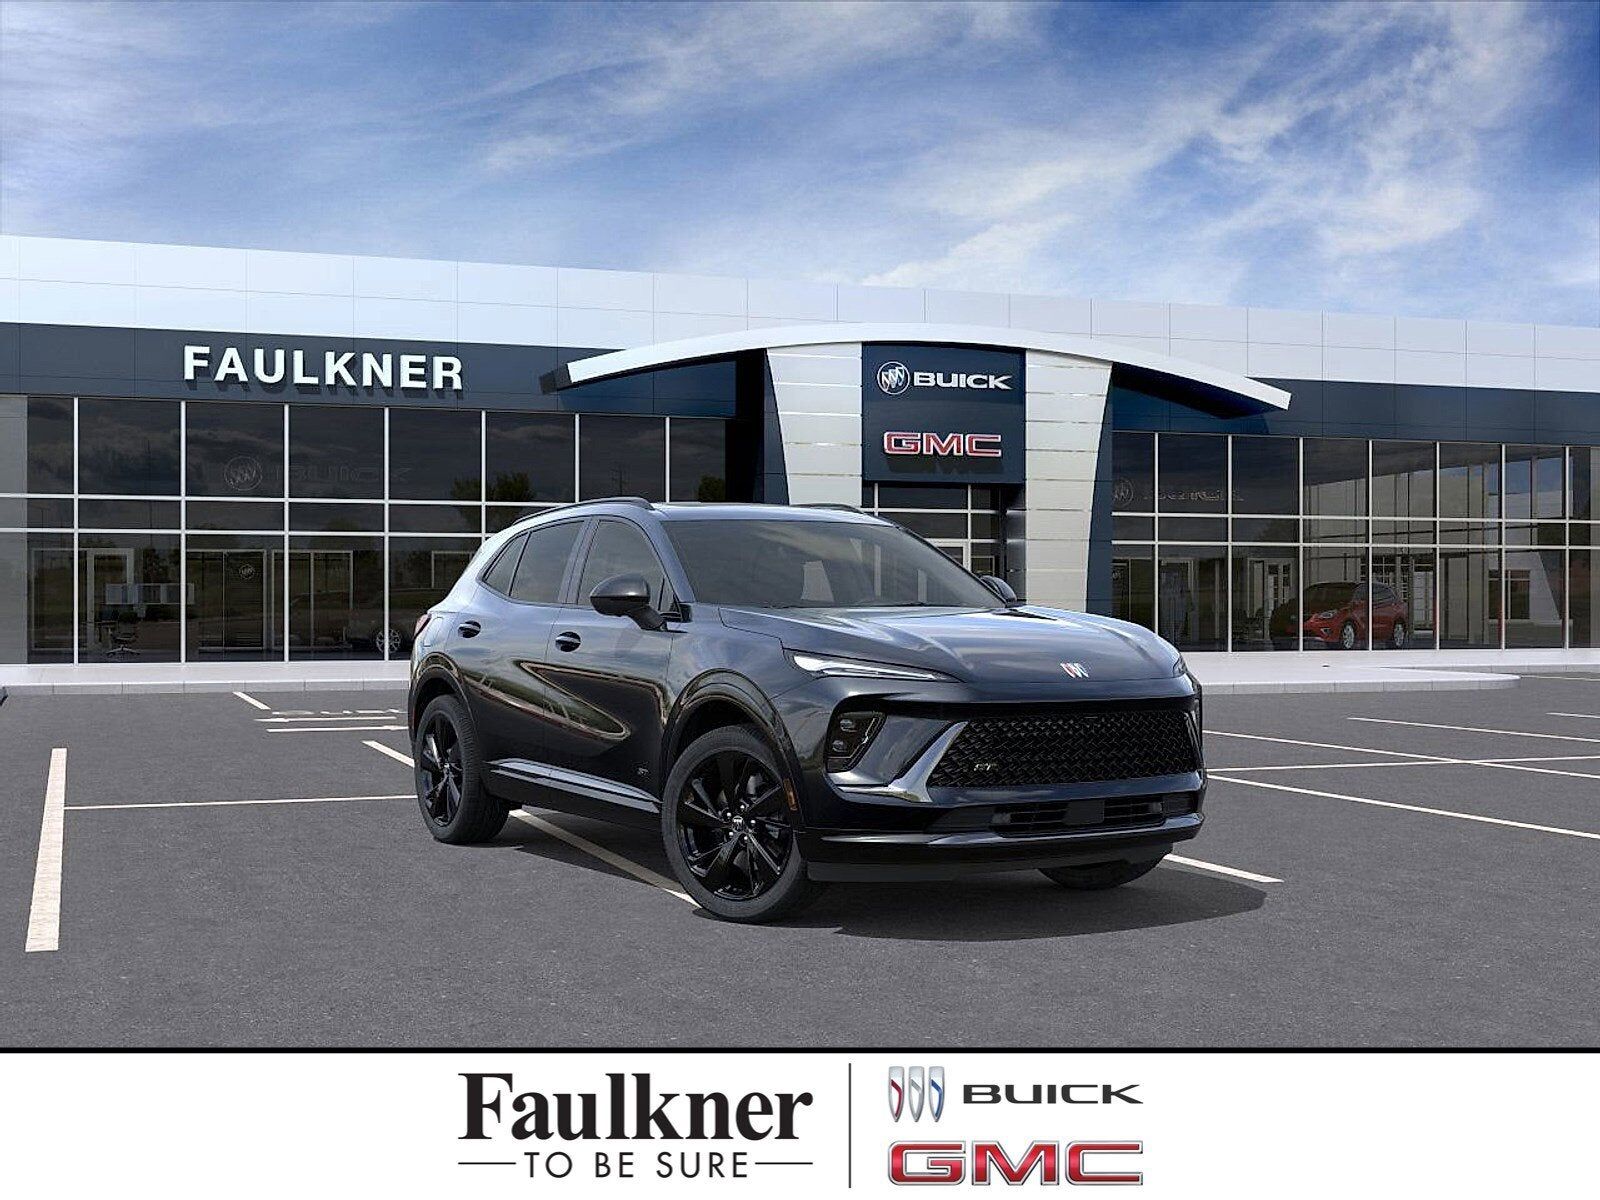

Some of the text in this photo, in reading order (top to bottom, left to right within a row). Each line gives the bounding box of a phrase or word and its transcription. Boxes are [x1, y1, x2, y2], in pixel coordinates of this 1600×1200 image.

[183, 345, 463, 390] FAULKNER
[913, 371, 1013, 390] BUICK
[883, 431, 1002, 457] GMC
